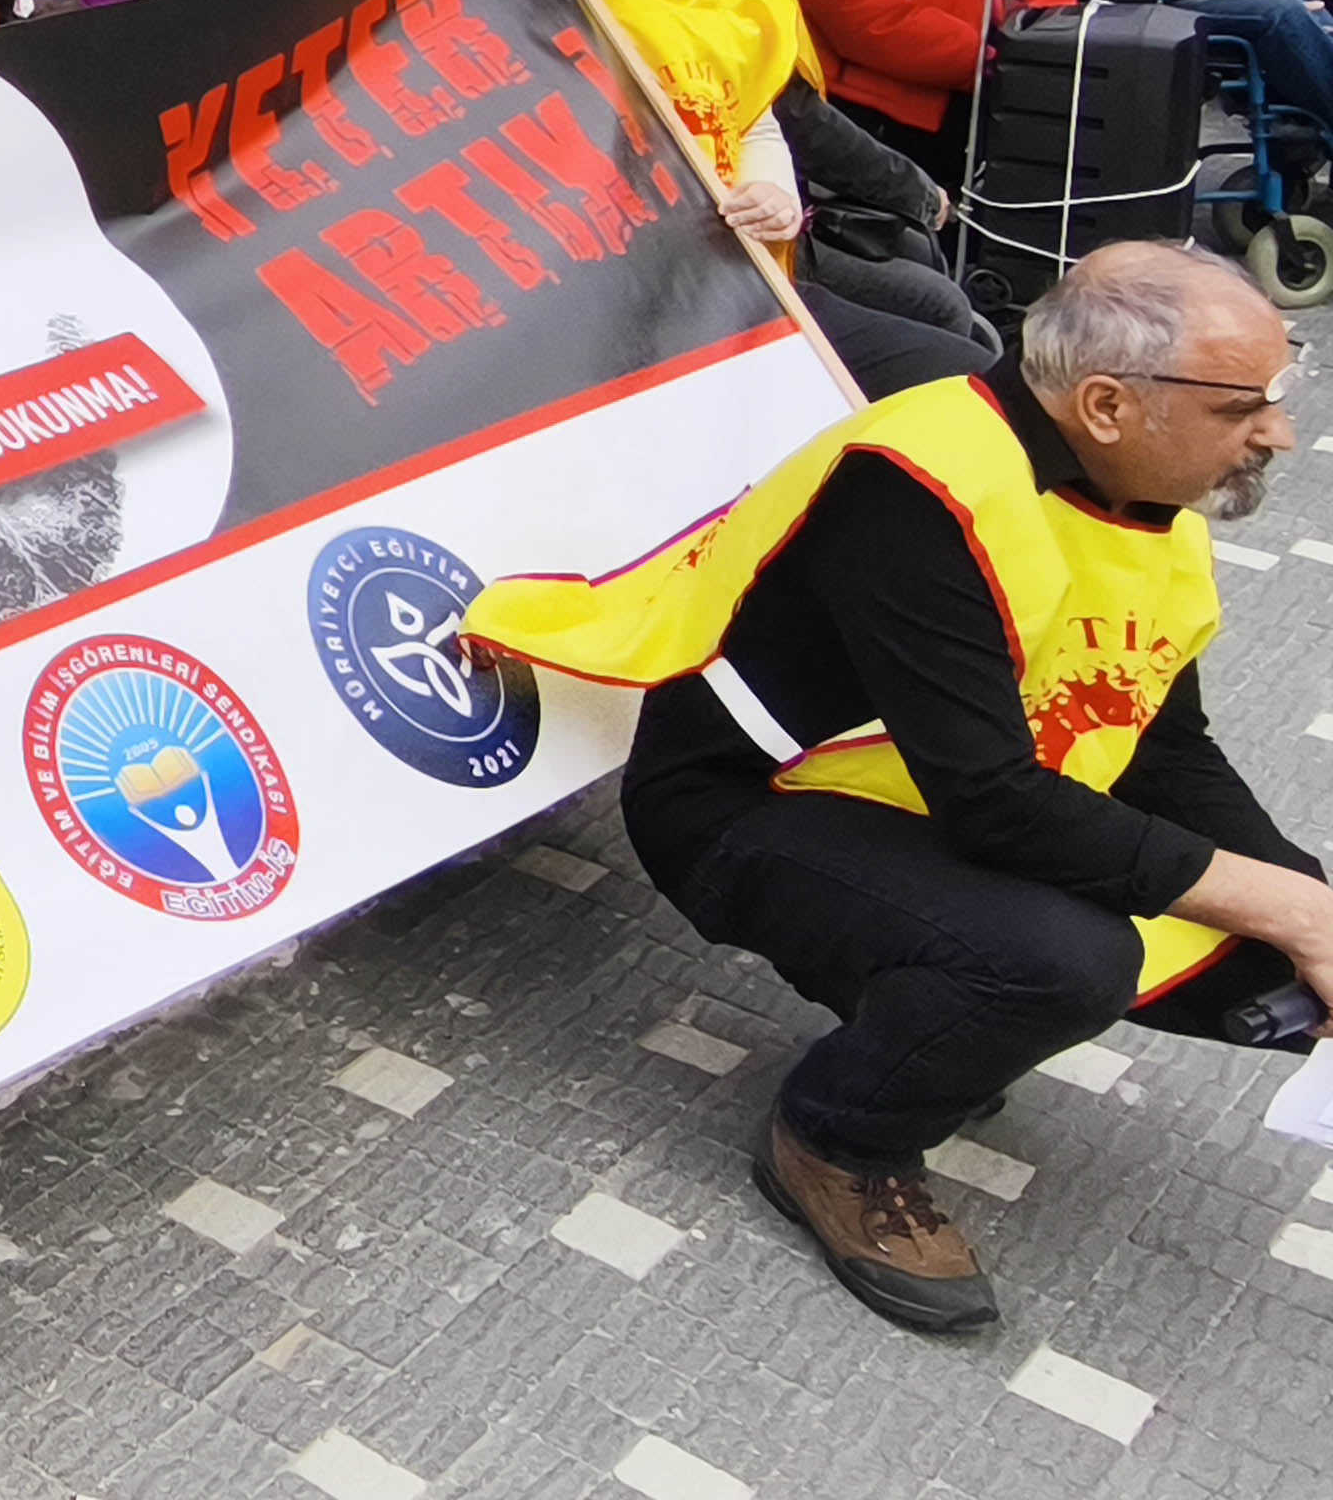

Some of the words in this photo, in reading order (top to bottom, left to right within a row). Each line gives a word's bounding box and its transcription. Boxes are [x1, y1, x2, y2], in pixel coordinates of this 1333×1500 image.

[368, 537, 469, 591] EĞİTİM
[48, 642, 201, 693] İŞGÖRENLERİ
[28, 690, 60, 761] BİLİM
[202, 681, 288, 815] SENDİKASI
[36, 768, 60, 802] VE
[467, 739, 521, 777] 2021
[52, 808, 134, 890] EĞİTİM
